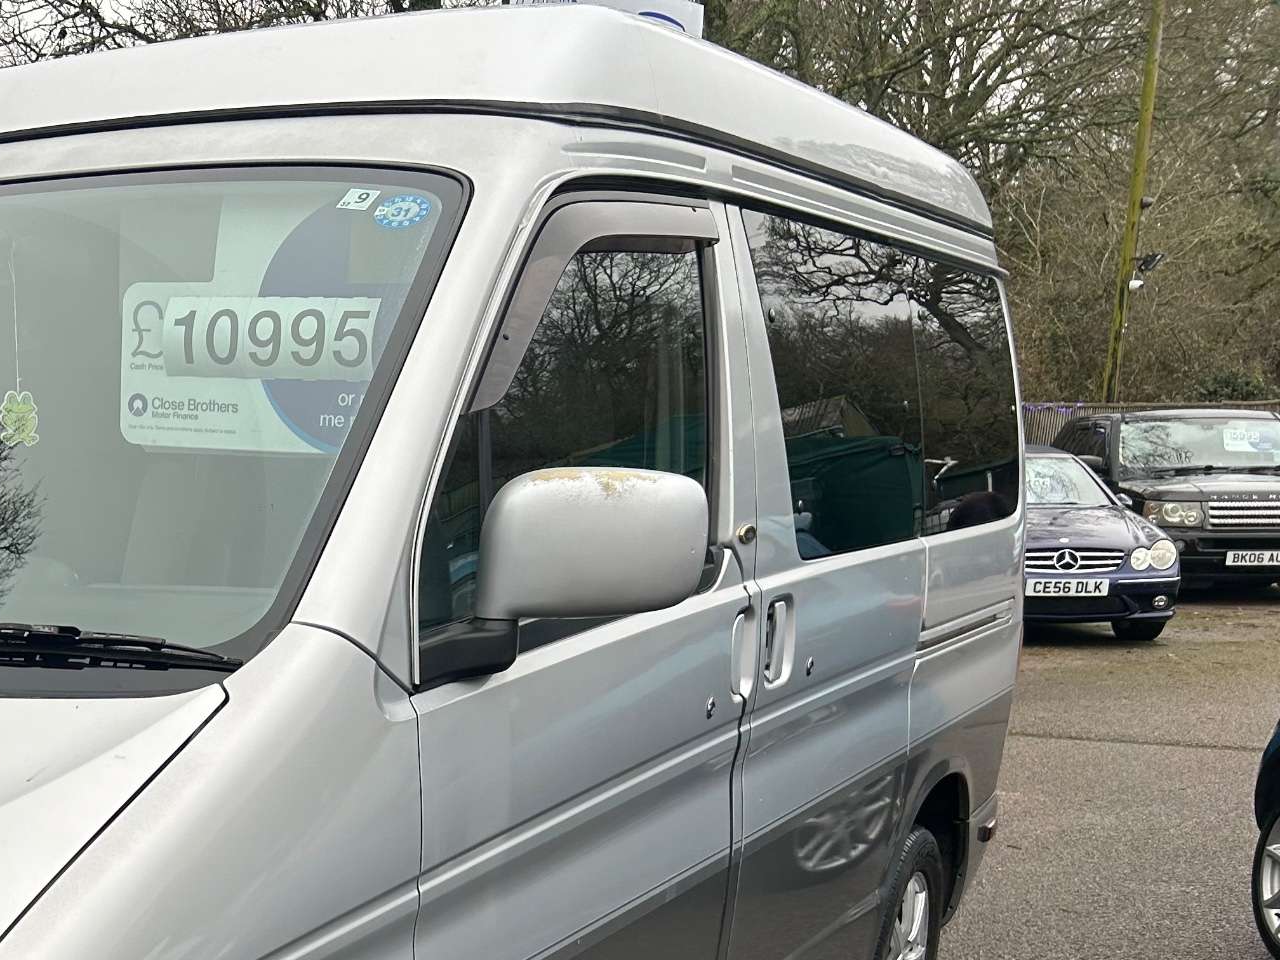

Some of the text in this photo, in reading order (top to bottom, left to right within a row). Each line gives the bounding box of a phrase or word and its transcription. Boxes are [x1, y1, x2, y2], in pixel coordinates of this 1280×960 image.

[151, 397, 239, 414] Close Brothers
[338, 393, 356, 406] or
[151, 411, 199, 421] Motor Finance
[319, 414, 345, 427] me
[1232, 552, 1265, 564] BK06
[1033, 581, 1103, 594] CE56 DLK
